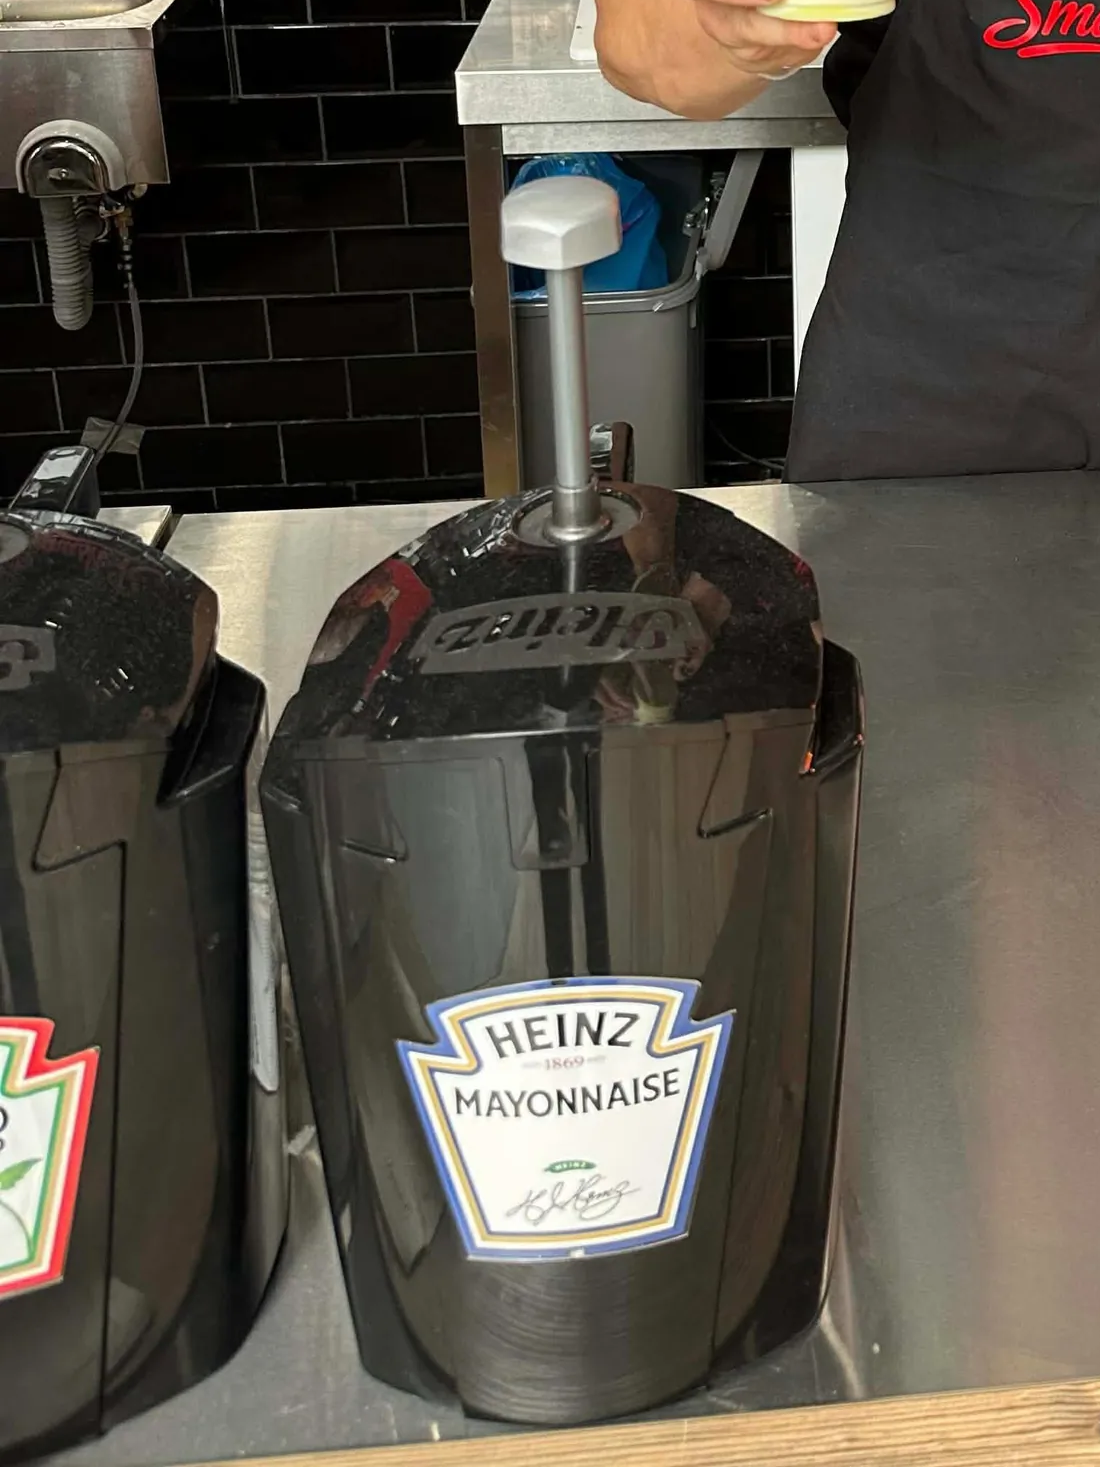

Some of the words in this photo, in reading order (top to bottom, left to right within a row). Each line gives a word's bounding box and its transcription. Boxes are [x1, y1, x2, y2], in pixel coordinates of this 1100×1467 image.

[485, 1011, 641, 1059] HEINZ
[544, 1055, 585, 1071] 1869
[454, 1067, 681, 1118] MAYONNAISE
